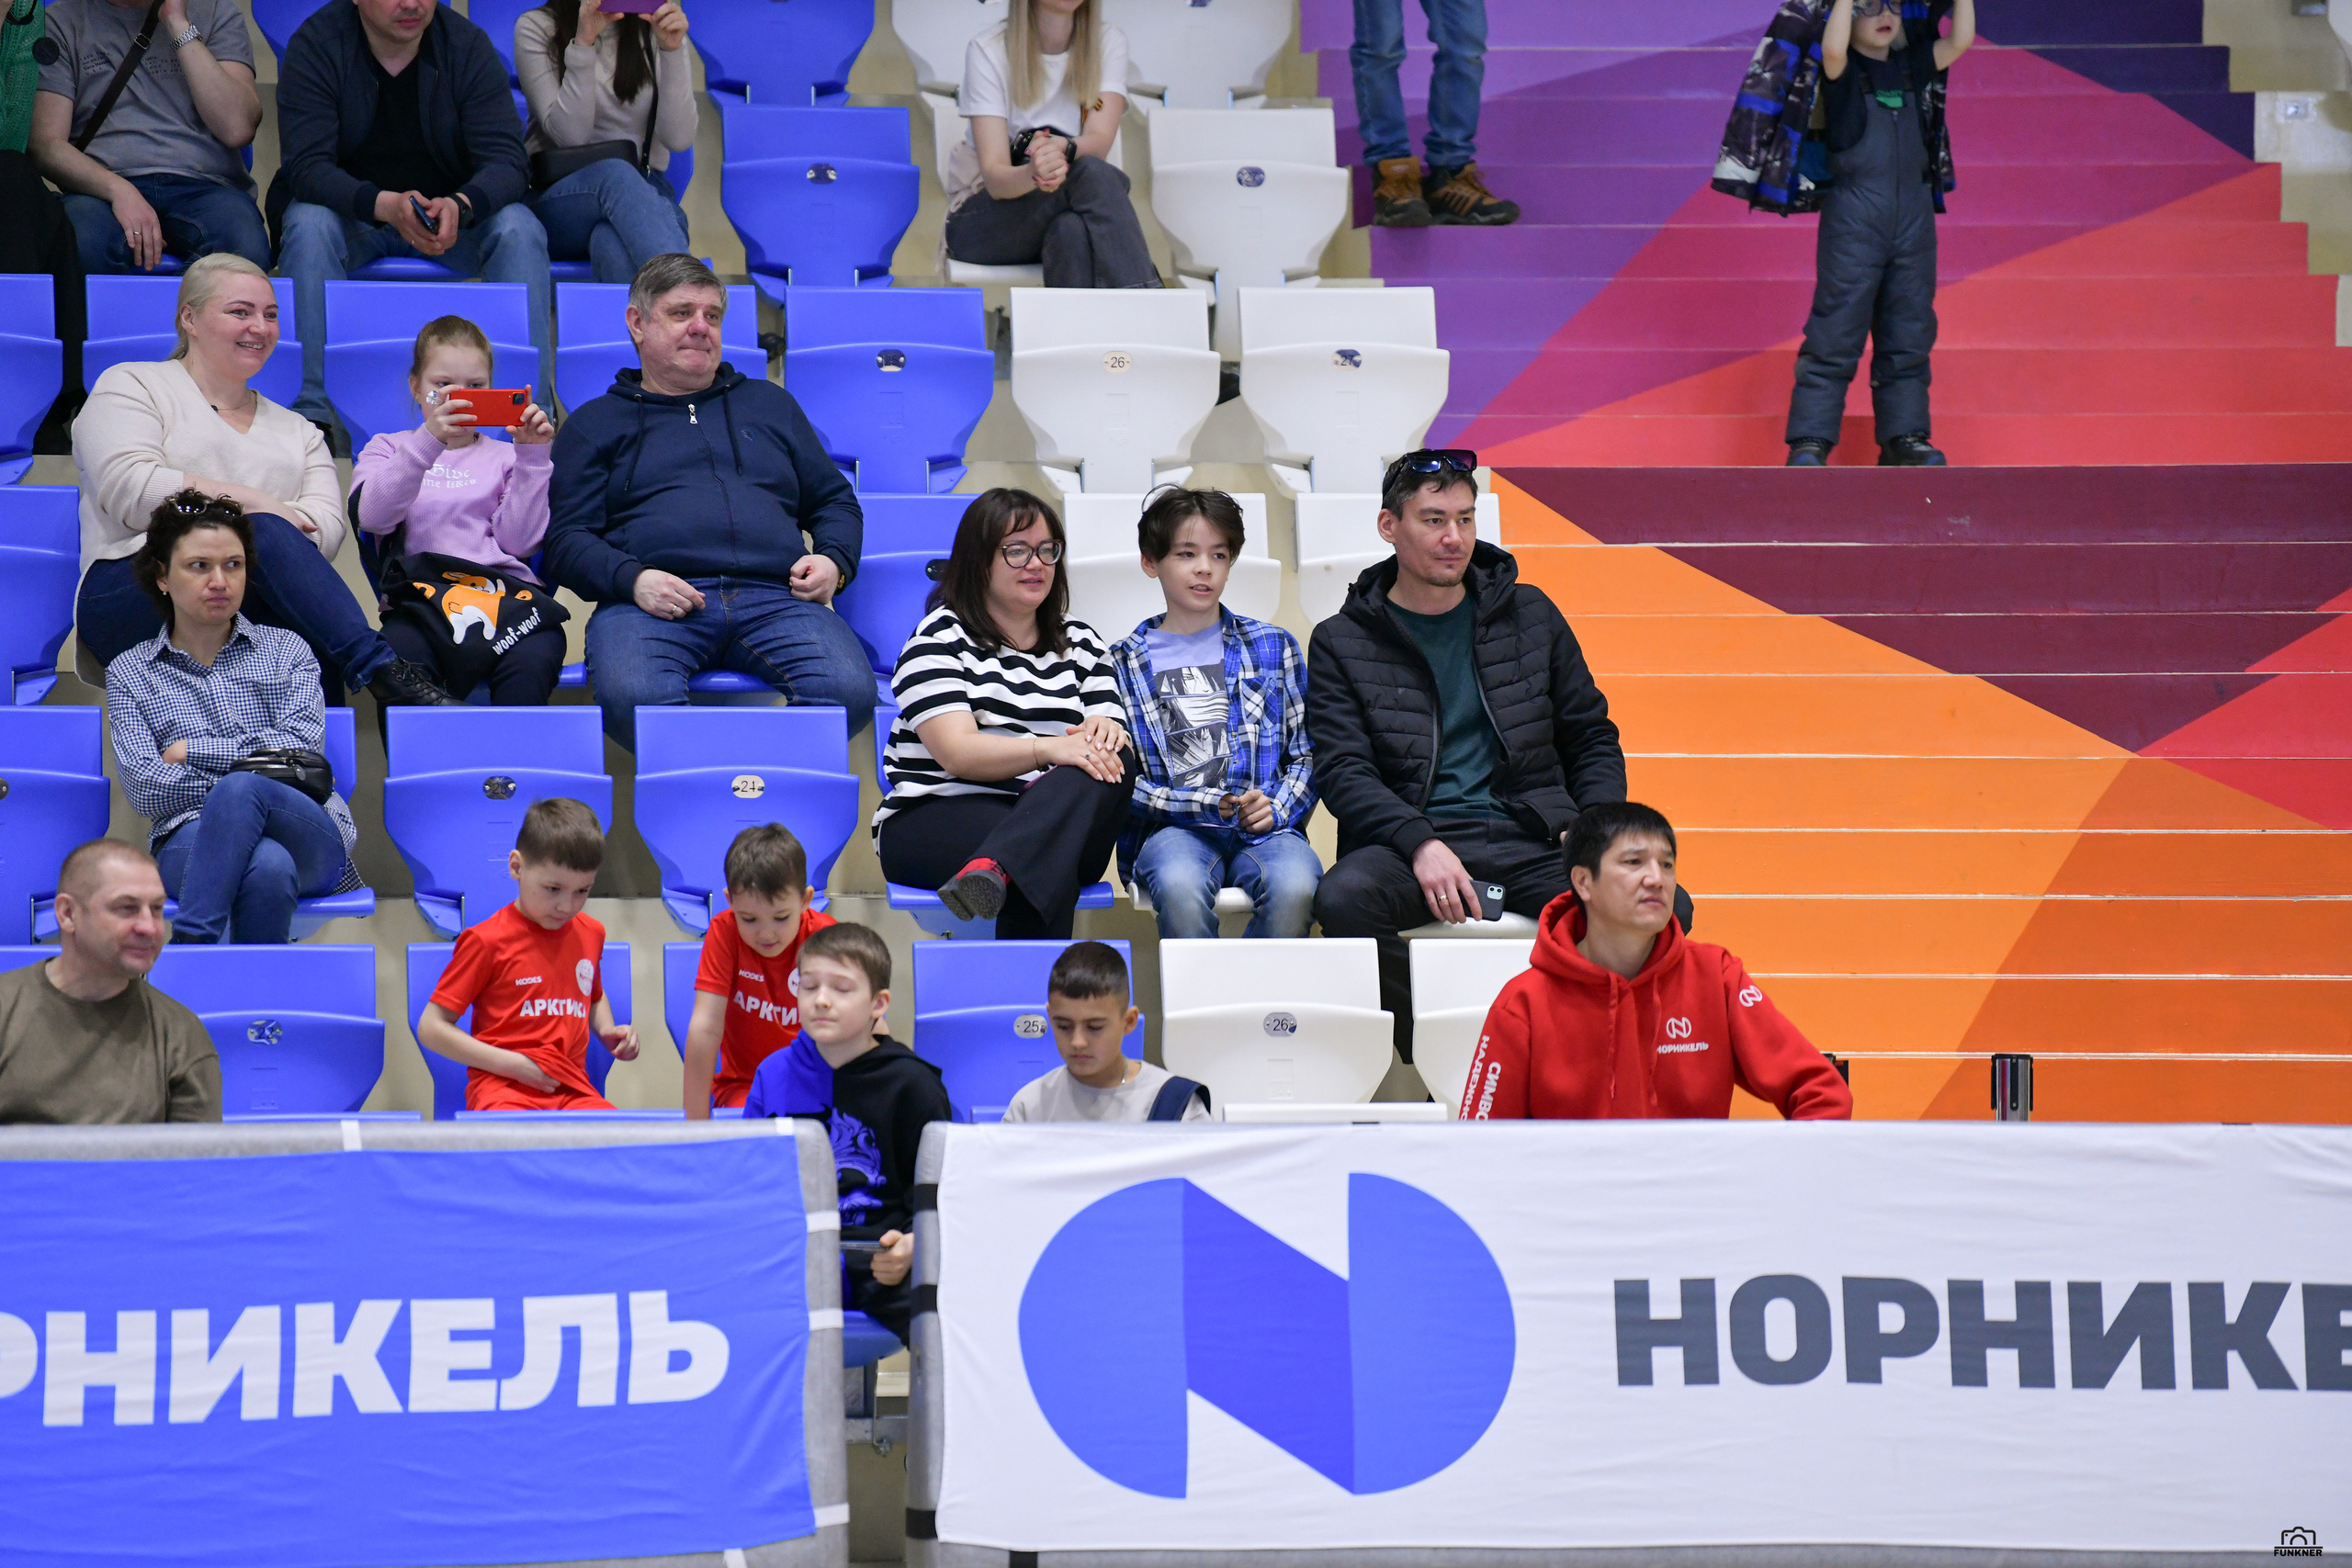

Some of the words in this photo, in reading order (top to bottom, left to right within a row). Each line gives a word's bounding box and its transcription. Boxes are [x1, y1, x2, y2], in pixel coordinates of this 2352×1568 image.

[1110, 356, 1125, 368] 26
[1340, 355, 1355, 367] 27
[492, 606, 541, 655] woof-woof
[514, 975, 543, 987] KODES
[738, 968, 765, 983] KODES
[733, 989, 798, 1027] АРКТИ
[1023, 1020, 1040, 1033] 25
[1272, 1018, 1289, 1032] 26
